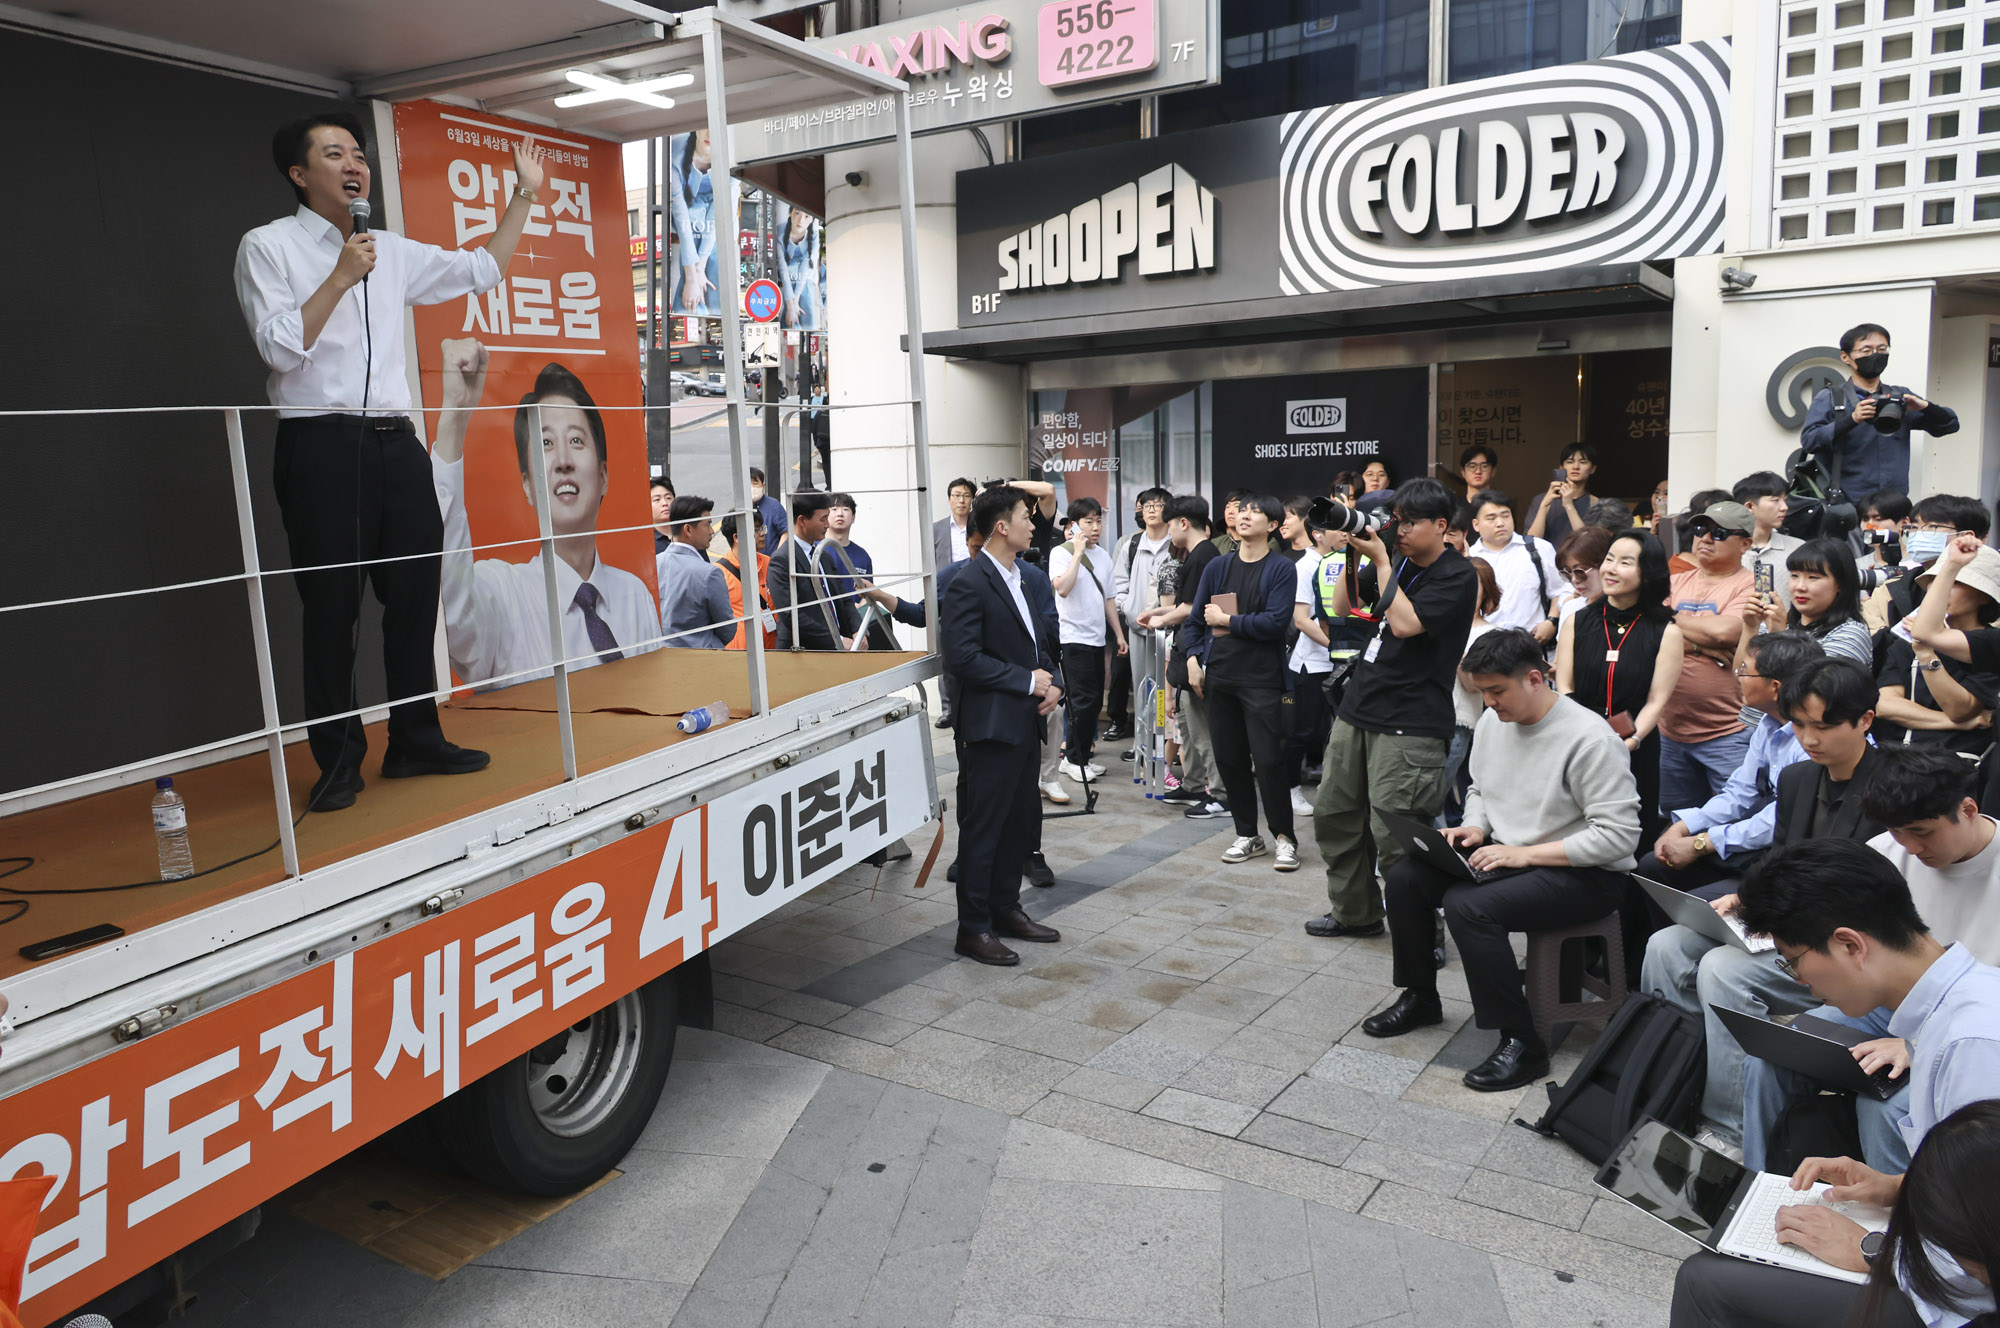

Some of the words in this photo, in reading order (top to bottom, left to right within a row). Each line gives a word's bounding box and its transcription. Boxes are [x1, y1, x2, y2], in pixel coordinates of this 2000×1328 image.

[1057, 35, 1134, 75] 4222
[1171, 40, 1194, 63] 7F
[764, 88, 938, 135] 바디/페이스/브라질리언/아브로우
[447, 127, 481, 147] 6월3일
[483, 134, 510, 152] 세상을
[572, 153, 589, 168] 방법
[1349, 112, 1626, 234] FOLDER
[998, 162, 1215, 291] SHOOPEN
[461, 271, 600, 339] 새로움
[750, 297, 777, 305] 주차금지
[972, 293, 1001, 315] B1F
[1292, 405, 1340, 427] FOLDER
[1458, 405, 1522, 424] 찾으시면
[1625, 396, 1665, 416] 40년
[1042, 412, 1082, 430] 편안함,
[1626, 418, 1670, 439] 성수
[1042, 432, 1079, 450] 일상이
[1082, 431, 1108, 448] 되다
[1458, 427, 1527, 446] 만듭니다.
[1255, 444, 1288, 459] SHOES
[1289, 442, 1343, 458] LIFESTYLE
[1345, 440, 1380, 456] STORE
[1042, 457, 1121, 473] COMFY.EZ
[743, 749, 888, 897] 이준석
[639, 807, 712, 962] 4
[0, 951, 354, 1305] 압도적
[373, 882, 612, 1099] 새로움
